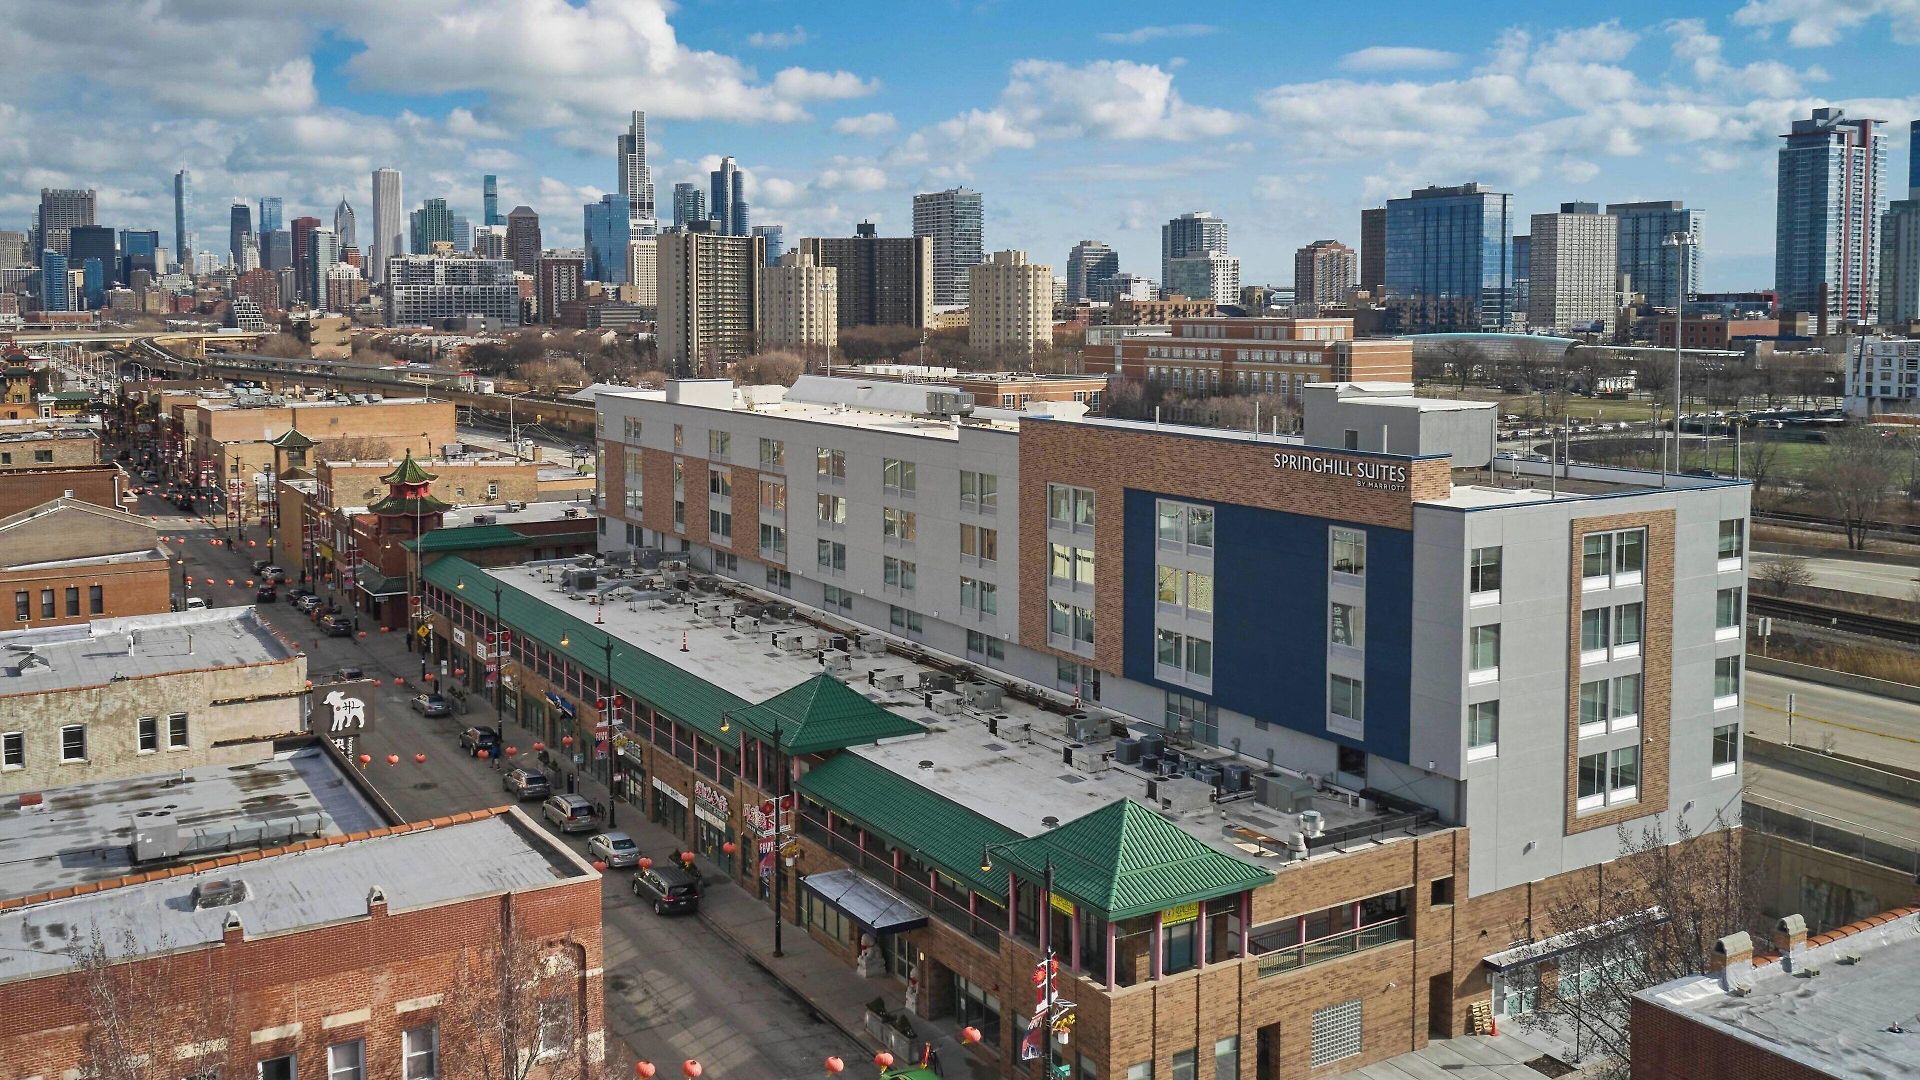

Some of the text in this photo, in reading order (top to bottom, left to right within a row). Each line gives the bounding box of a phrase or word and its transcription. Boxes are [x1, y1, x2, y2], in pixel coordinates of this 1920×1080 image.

[1274, 453, 1406, 483] SPRINGHILL SUITES
[1368, 482, 1406, 492] MARRIOTT
